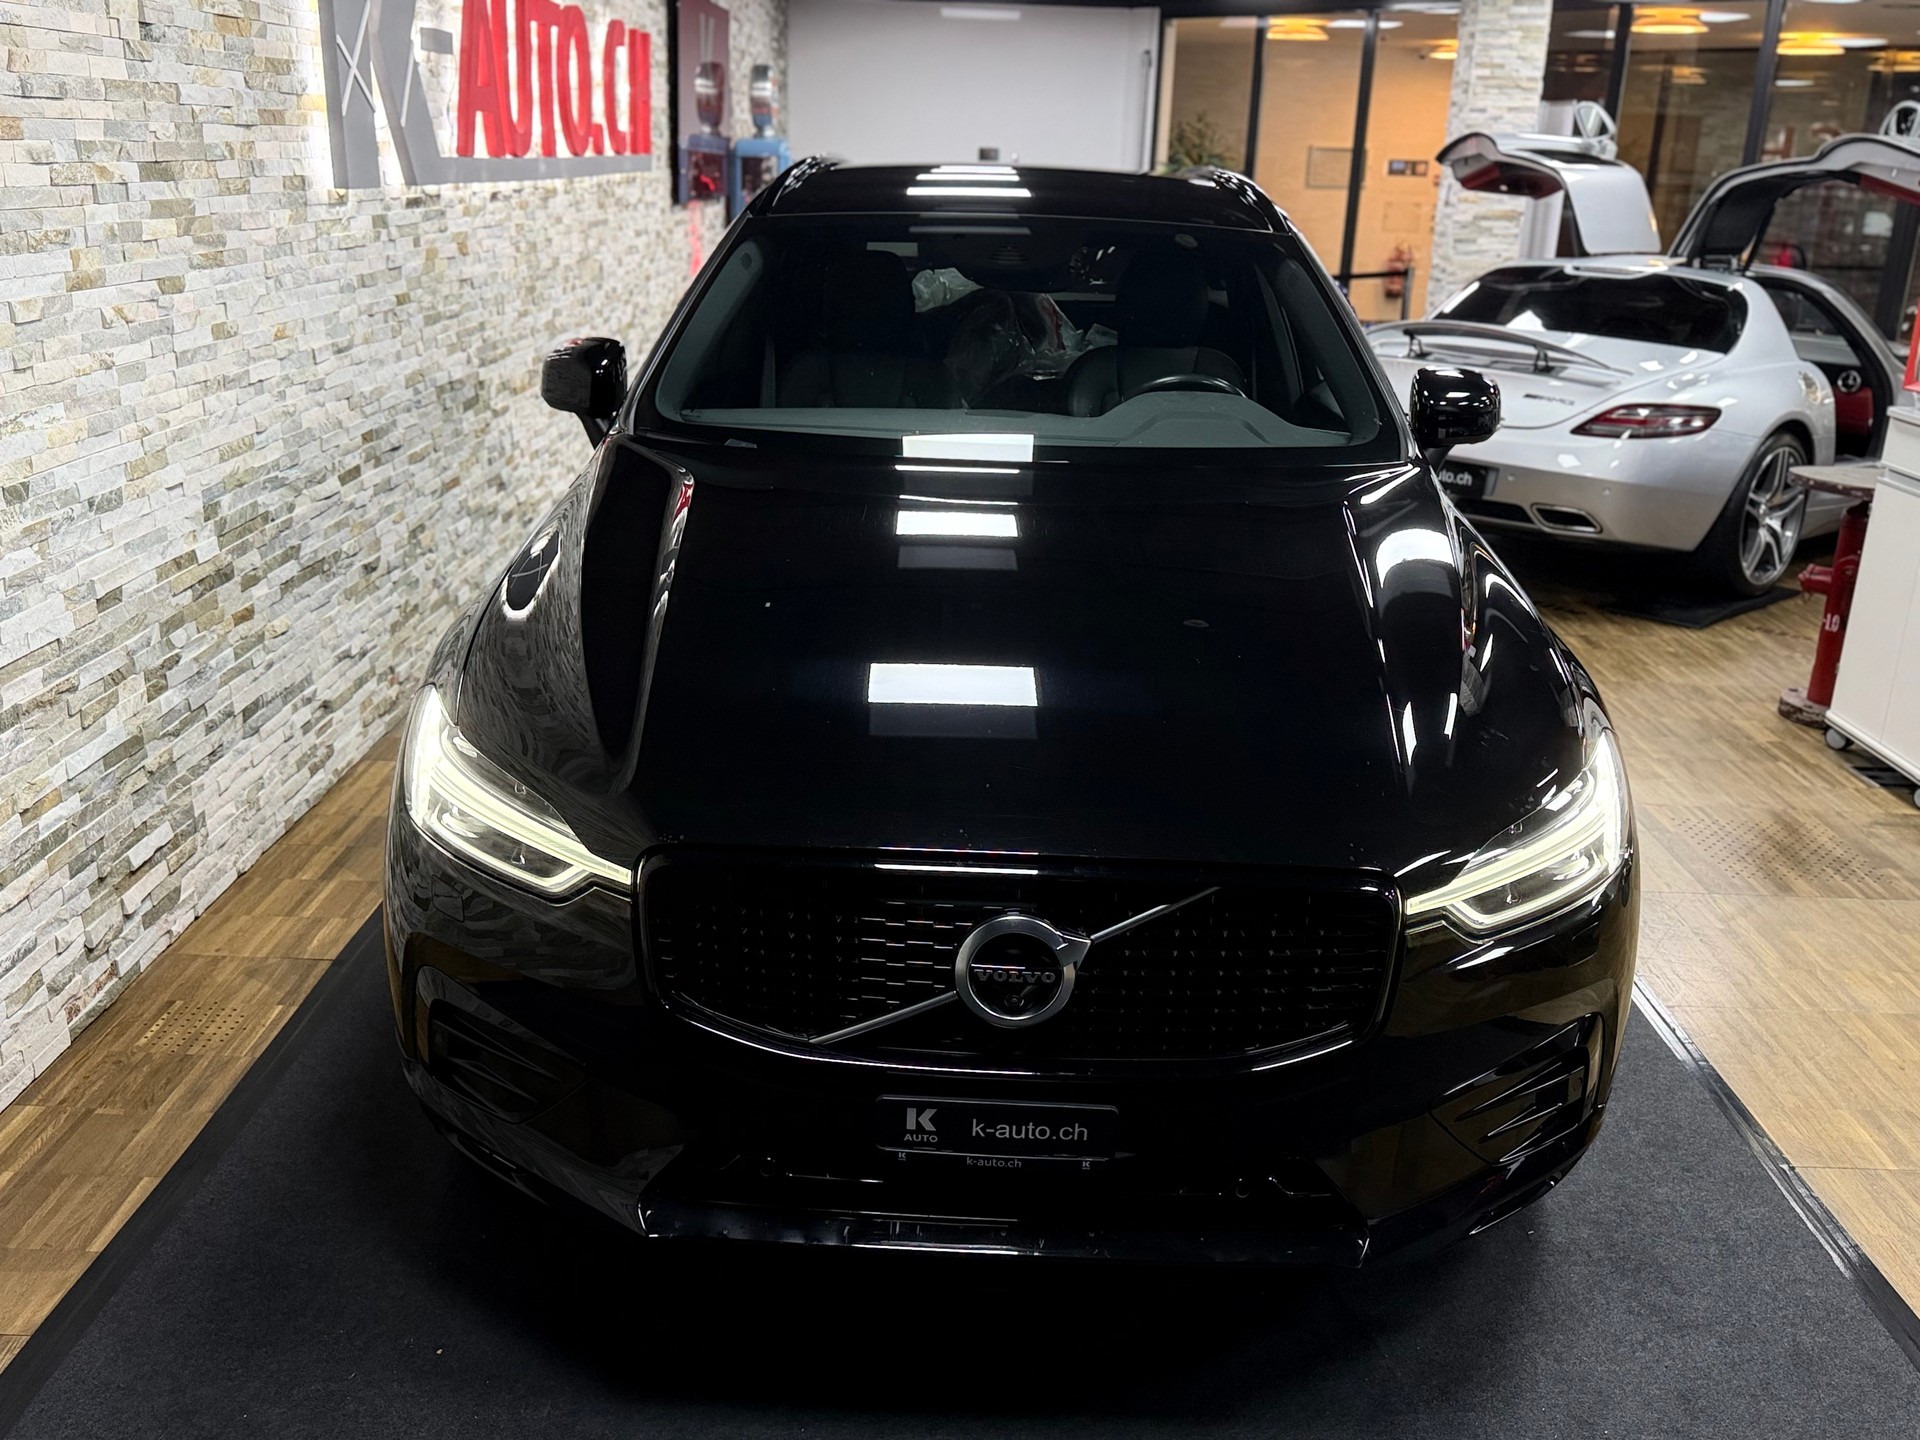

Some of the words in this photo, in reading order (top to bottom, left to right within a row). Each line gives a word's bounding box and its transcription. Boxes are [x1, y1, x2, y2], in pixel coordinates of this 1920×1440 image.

[973, 968, 1056, 984] VOLVO
[906, 1107, 938, 1132] K
[971, 1118, 1088, 1141] k-auto.ch
[903, 1133, 938, 1143] AUTO
[966, 1156, 1022, 1168] k-auto.ch
